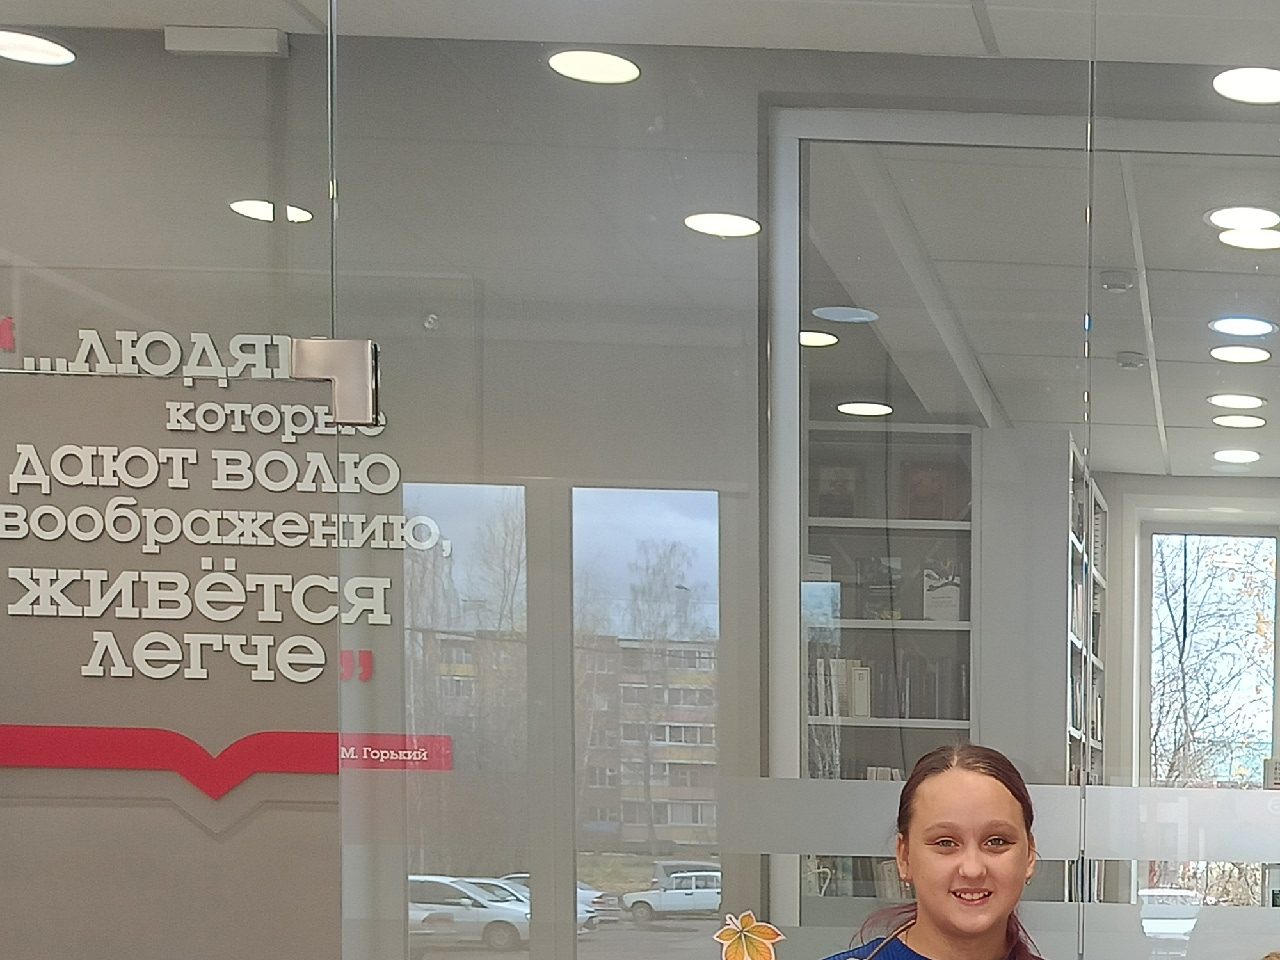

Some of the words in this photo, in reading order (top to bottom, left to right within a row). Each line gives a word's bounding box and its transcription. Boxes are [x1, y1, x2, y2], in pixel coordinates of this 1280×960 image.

[9, 444, 198, 495] дают
[211, 450, 401, 495] волю
[0, 496, 453, 557] воображению,
[7, 557, 393, 625] живётся
[340, 746, 358, 759] М.
[362, 747, 428, 762] Горький
